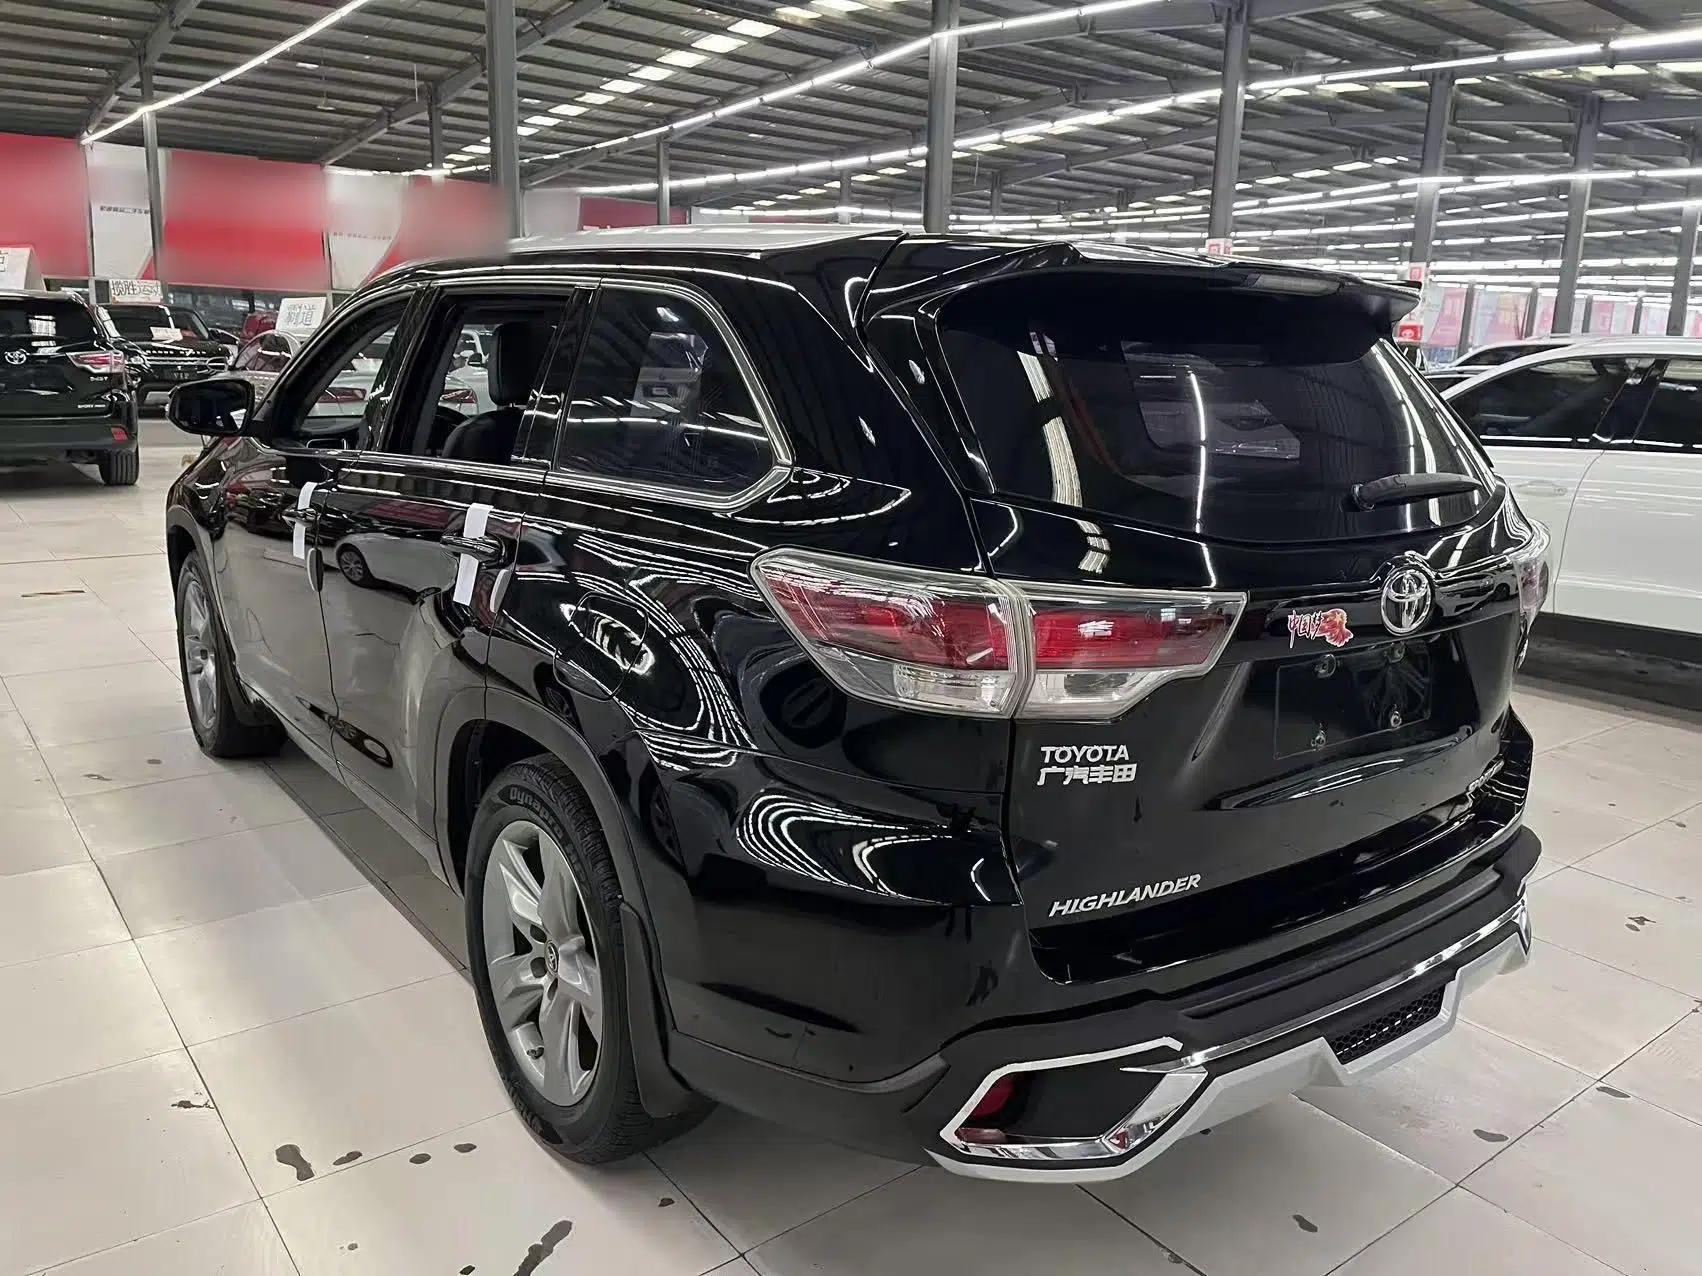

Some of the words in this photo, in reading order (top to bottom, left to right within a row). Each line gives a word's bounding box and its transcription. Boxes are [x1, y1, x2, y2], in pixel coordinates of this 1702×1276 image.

[1041, 744, 1130, 764] TOYOTA
[1037, 763, 1138, 786] 广汽丰田
[1049, 873, 1202, 918] HIGHLANDER
